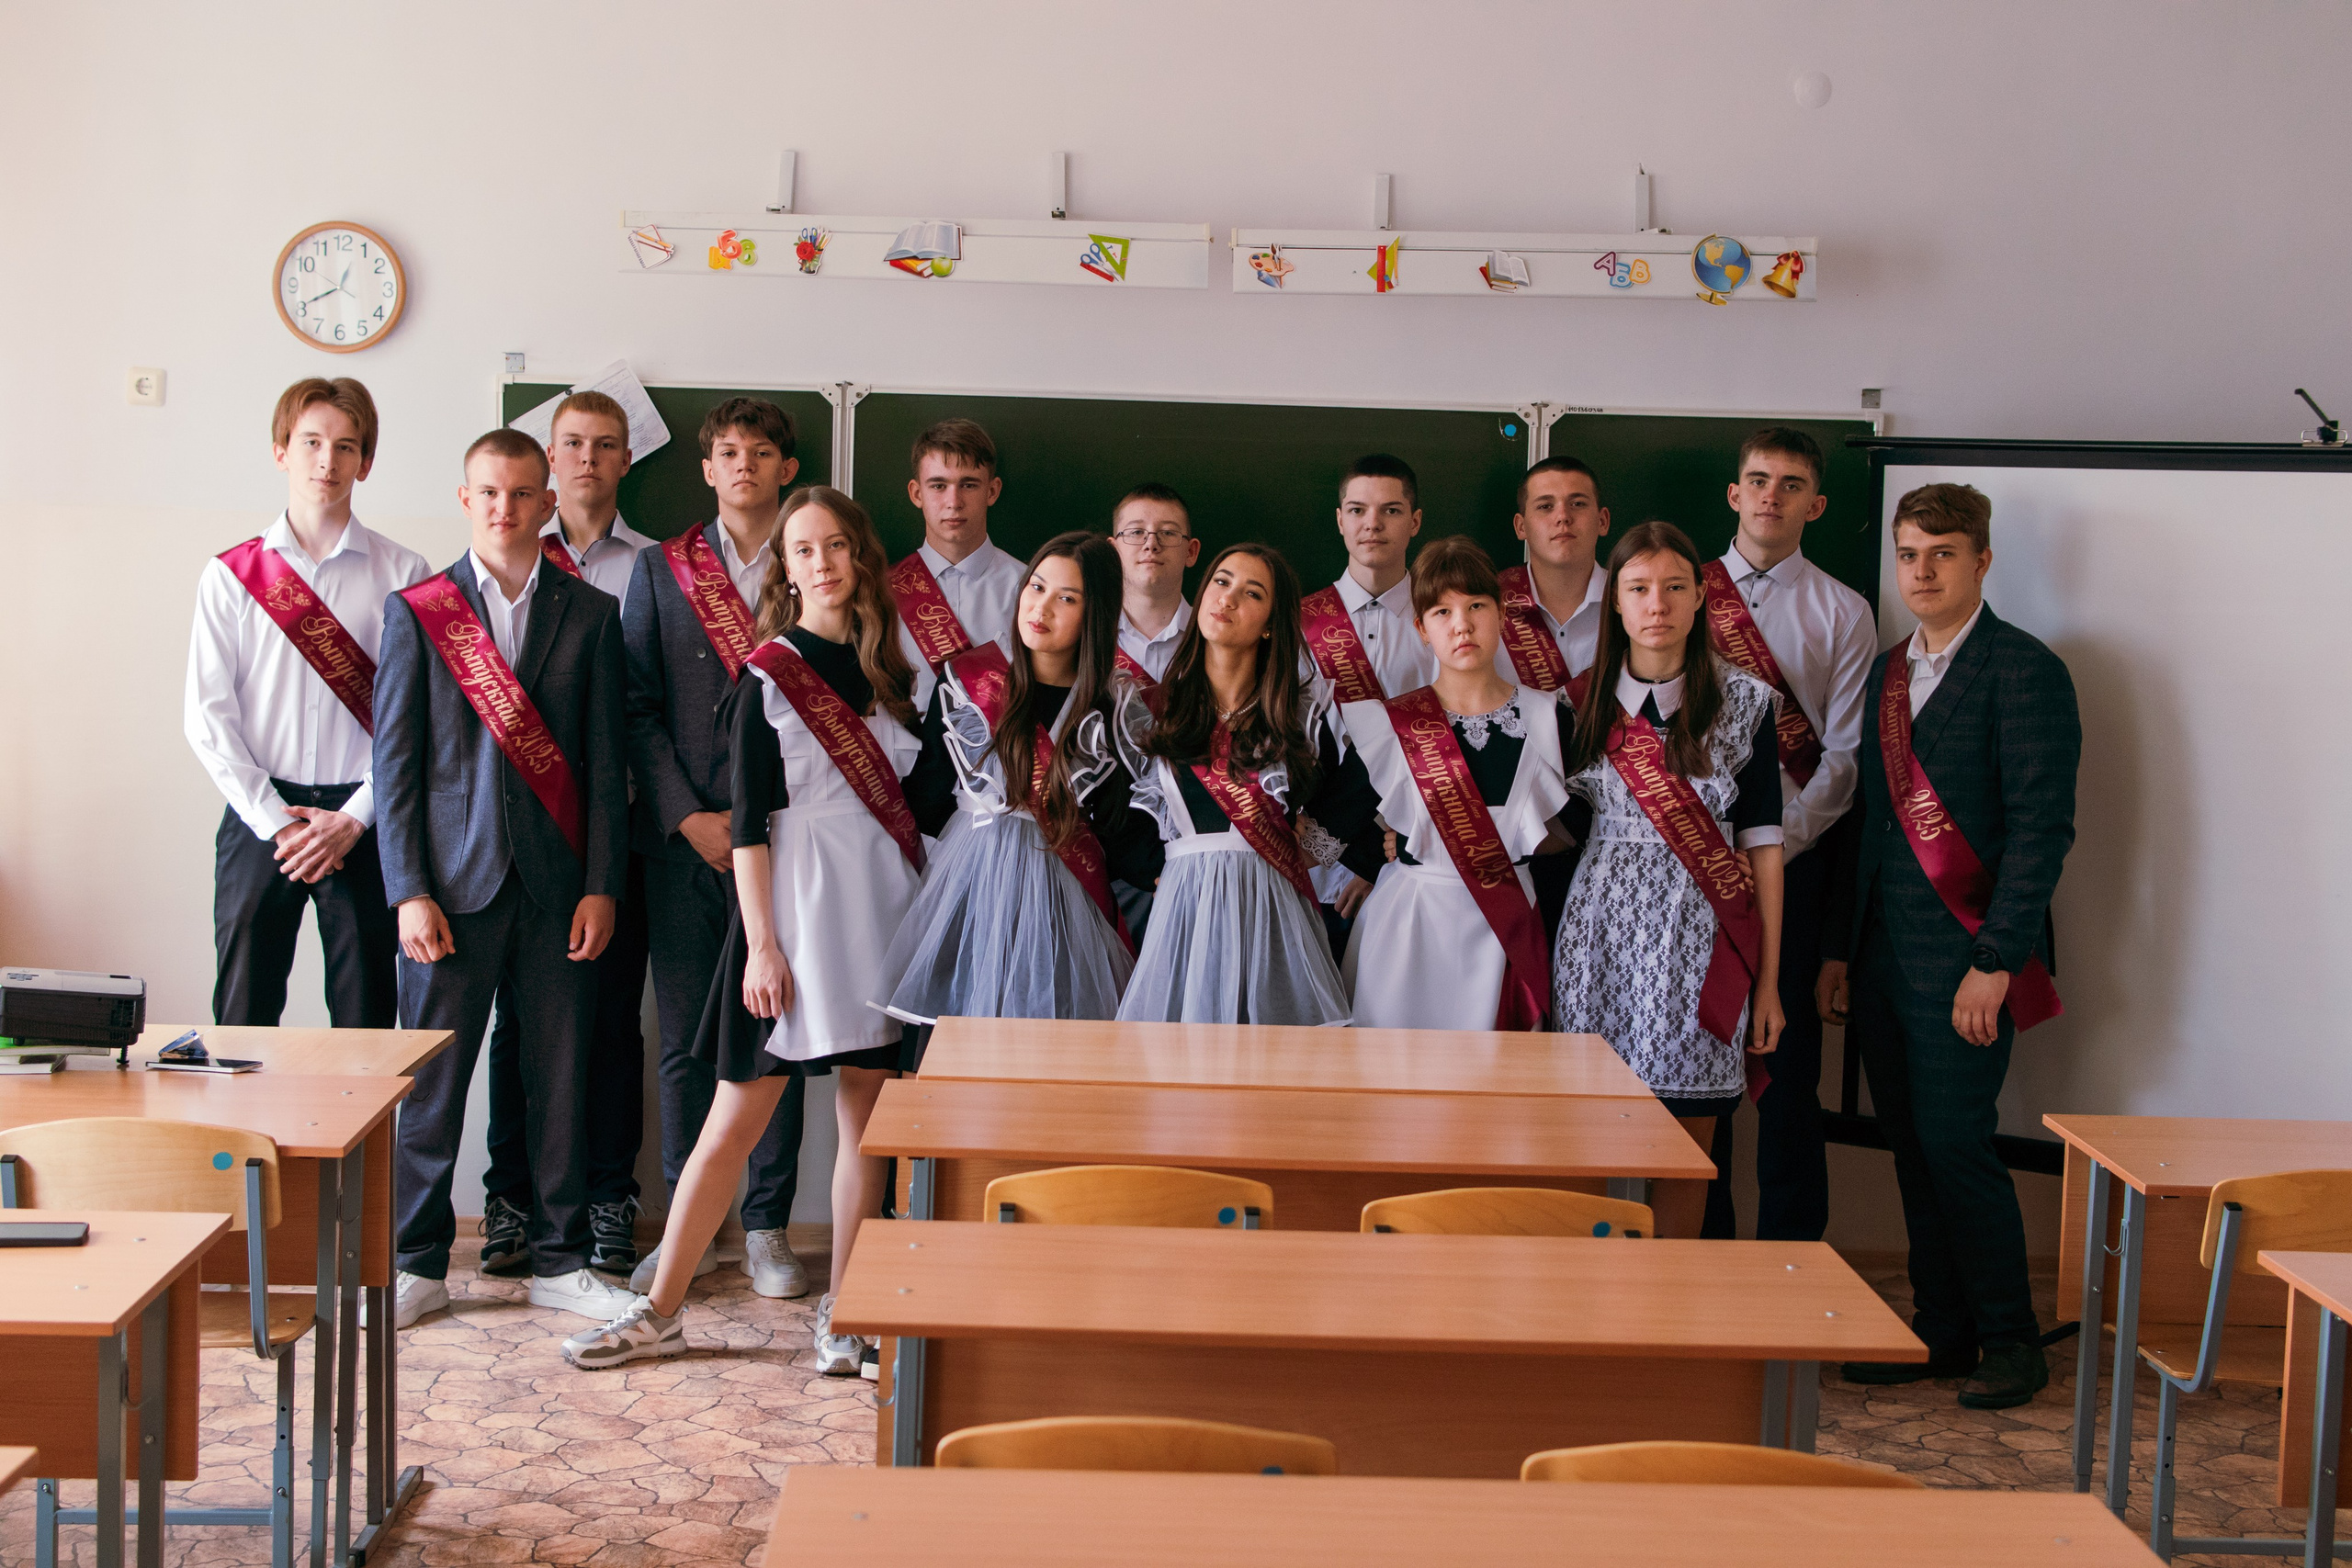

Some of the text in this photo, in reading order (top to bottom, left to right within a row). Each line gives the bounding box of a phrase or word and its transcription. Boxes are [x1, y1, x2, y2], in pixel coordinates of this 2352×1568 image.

[313, 240, 327, 256] 11
[334, 234, 353, 251] 12
[360, 242, 368, 258] 1
[297, 255, 315, 273] 10
[374, 258, 385, 274] 2
[288, 276, 299, 294] 9
[382, 281, 393, 299] 3
[296, 300, 307, 318] 8
[373, 305, 384, 321] 4
[313, 318, 324, 333] 7
[334, 324, 345, 341] 6
[357, 320, 368, 336] 5
[1503, 589, 1556, 690] Выпускни
[300, 615, 374, 708] Выпускни
[446, 620, 562, 774] Выпускник 2025
[806, 694, 889, 807] Выпускница
[1883, 678, 1953, 840] Выпускник 2025
[1410, 717, 1514, 889] Выпускница 2025
[1621, 734, 1745, 900] Выпускница 2025
